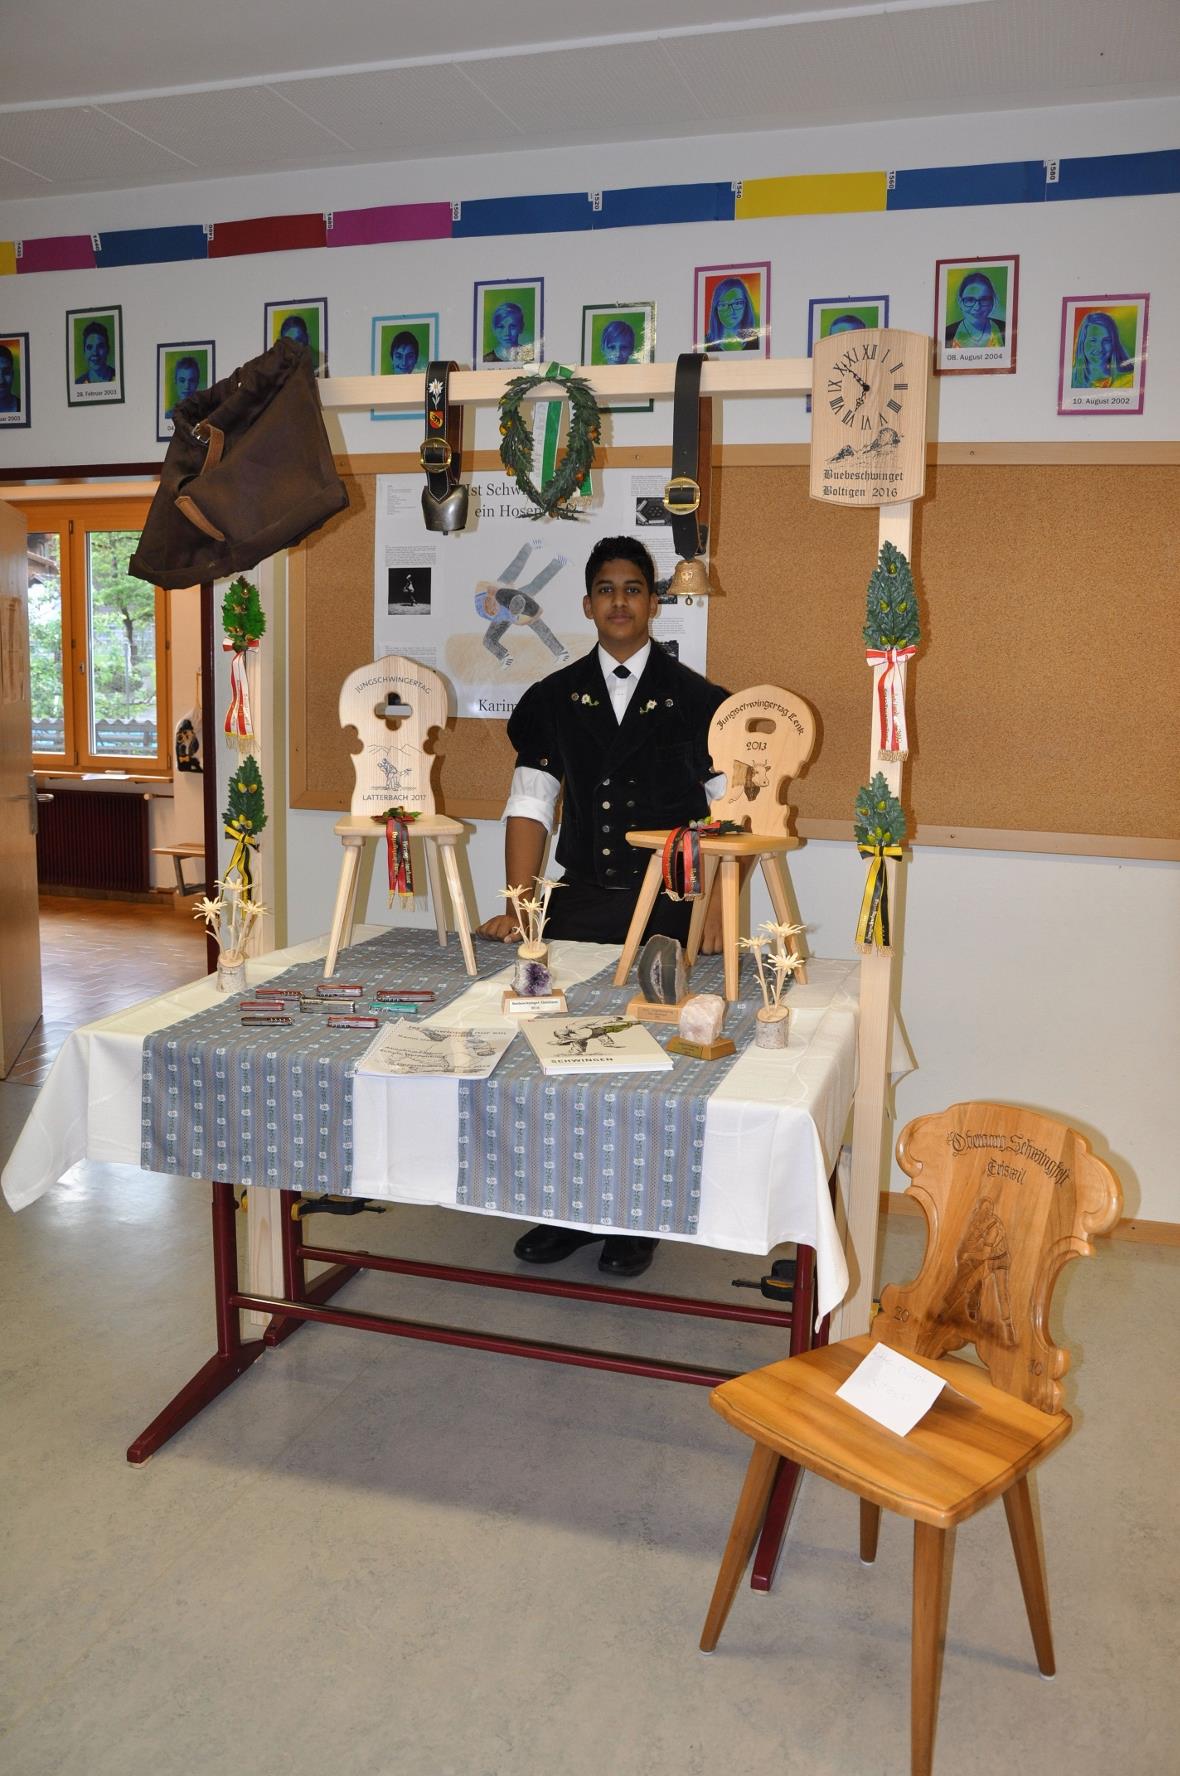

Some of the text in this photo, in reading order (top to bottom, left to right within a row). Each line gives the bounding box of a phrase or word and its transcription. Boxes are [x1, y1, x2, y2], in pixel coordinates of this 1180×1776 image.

[1049, 162, 1057, 180] 1580
[959, 354, 983, 362] August
[1085, 398, 1109, 406] August
[1111, 397, 1130, 405] 2002
[823, 485, 898, 498] Boltigen 2016
[475, 504, 495, 518] ein
[354, 675, 432, 694] JUNGSCHWINGERTAG
[746, 741, 768, 751] 2013
[551, 1056, 614, 1065] SCHWINGEN
[987, 1157, 1027, 1185] Eriswil
